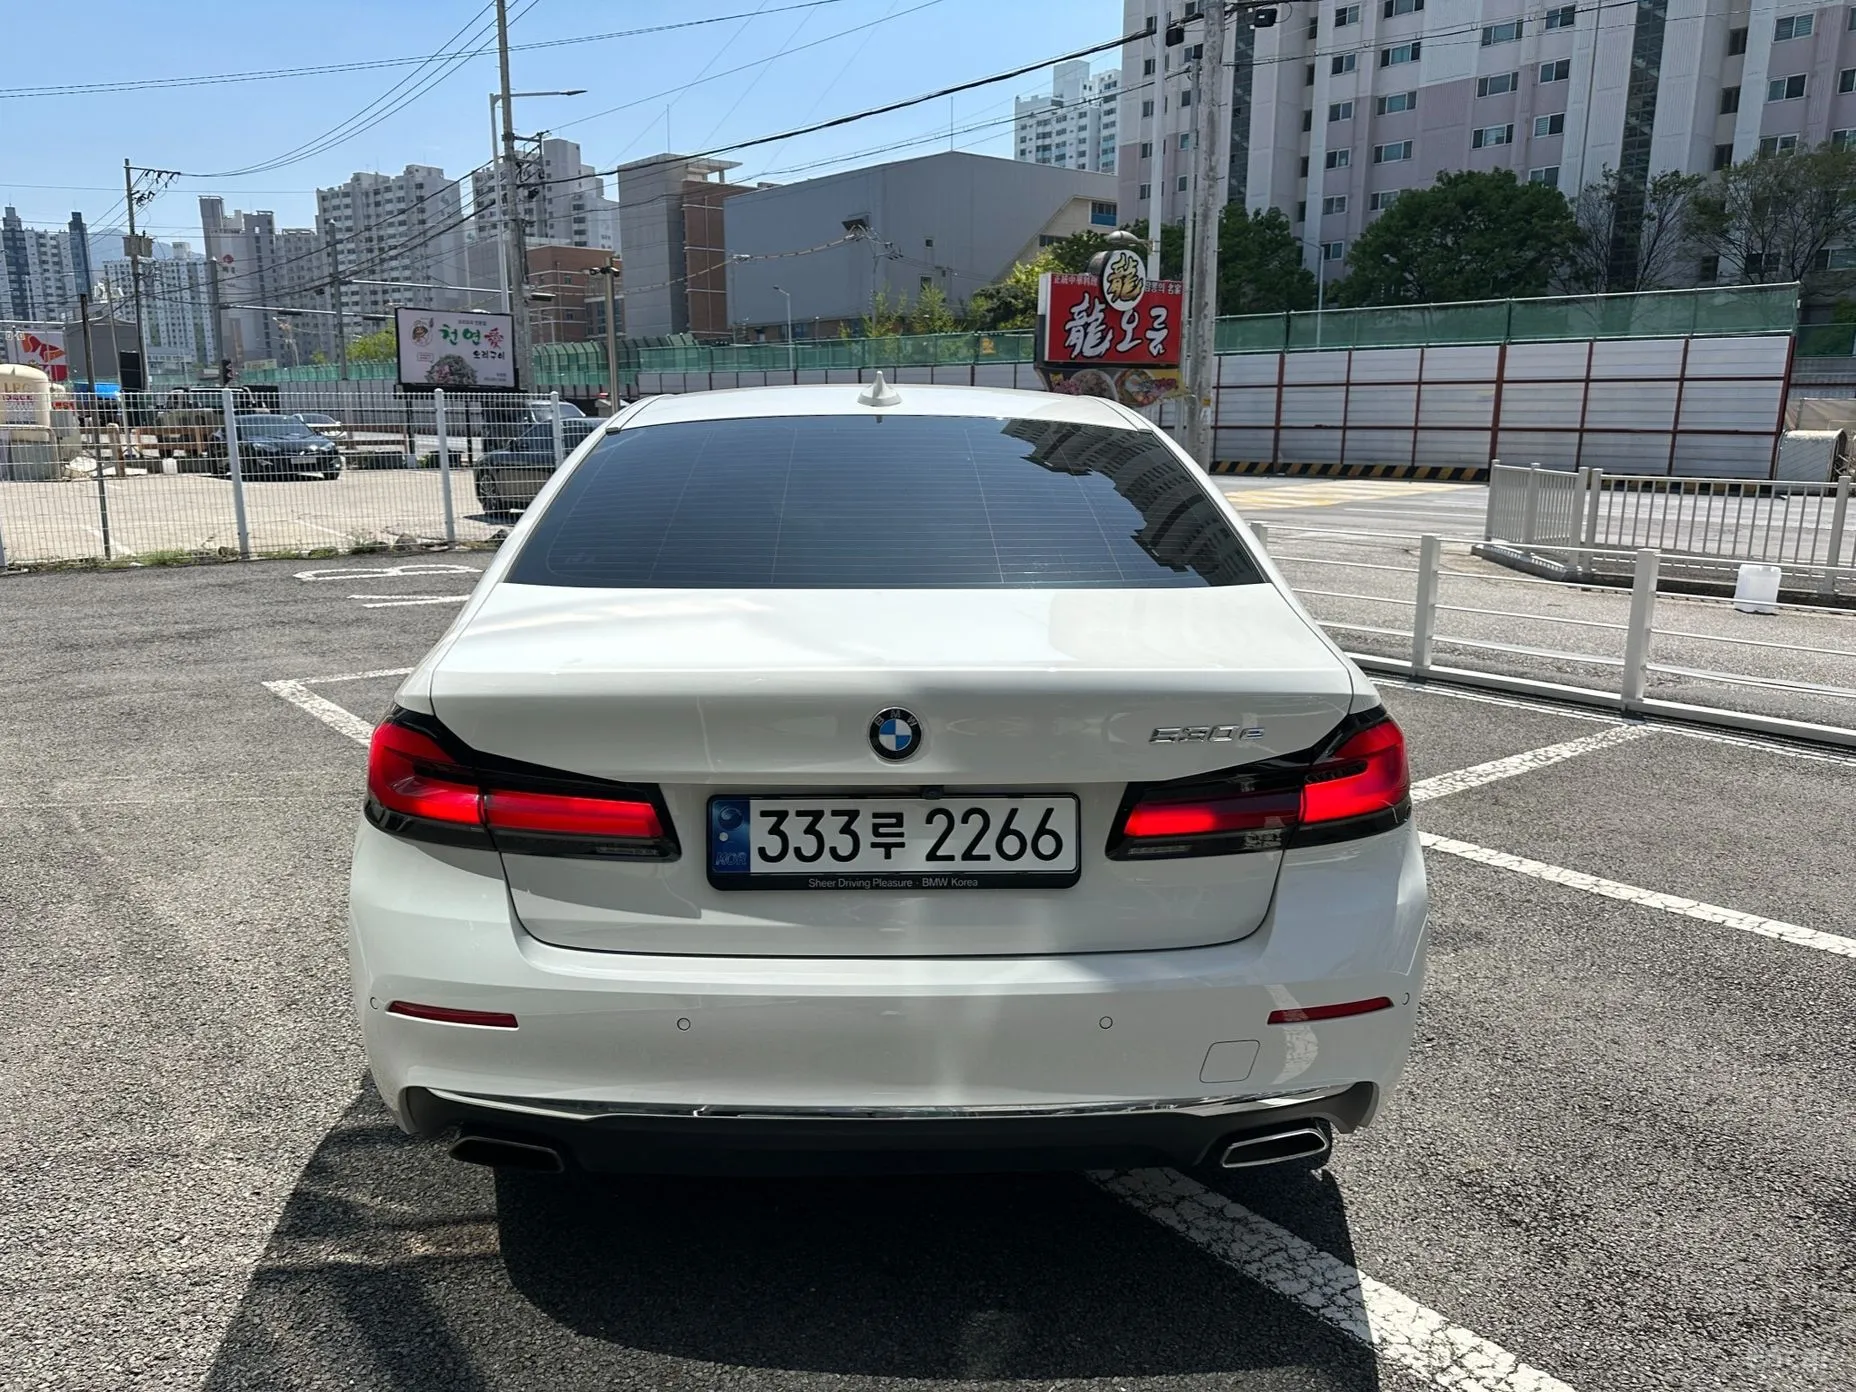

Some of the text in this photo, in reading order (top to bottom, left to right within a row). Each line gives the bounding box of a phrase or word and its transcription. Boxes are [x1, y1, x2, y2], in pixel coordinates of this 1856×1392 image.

[473, 350, 505, 360] 오리구이
[757, 807, 1064, 863] 333루 2266
[808, 877, 979, 890] Sheer Driving Pleasure BMW Korea
